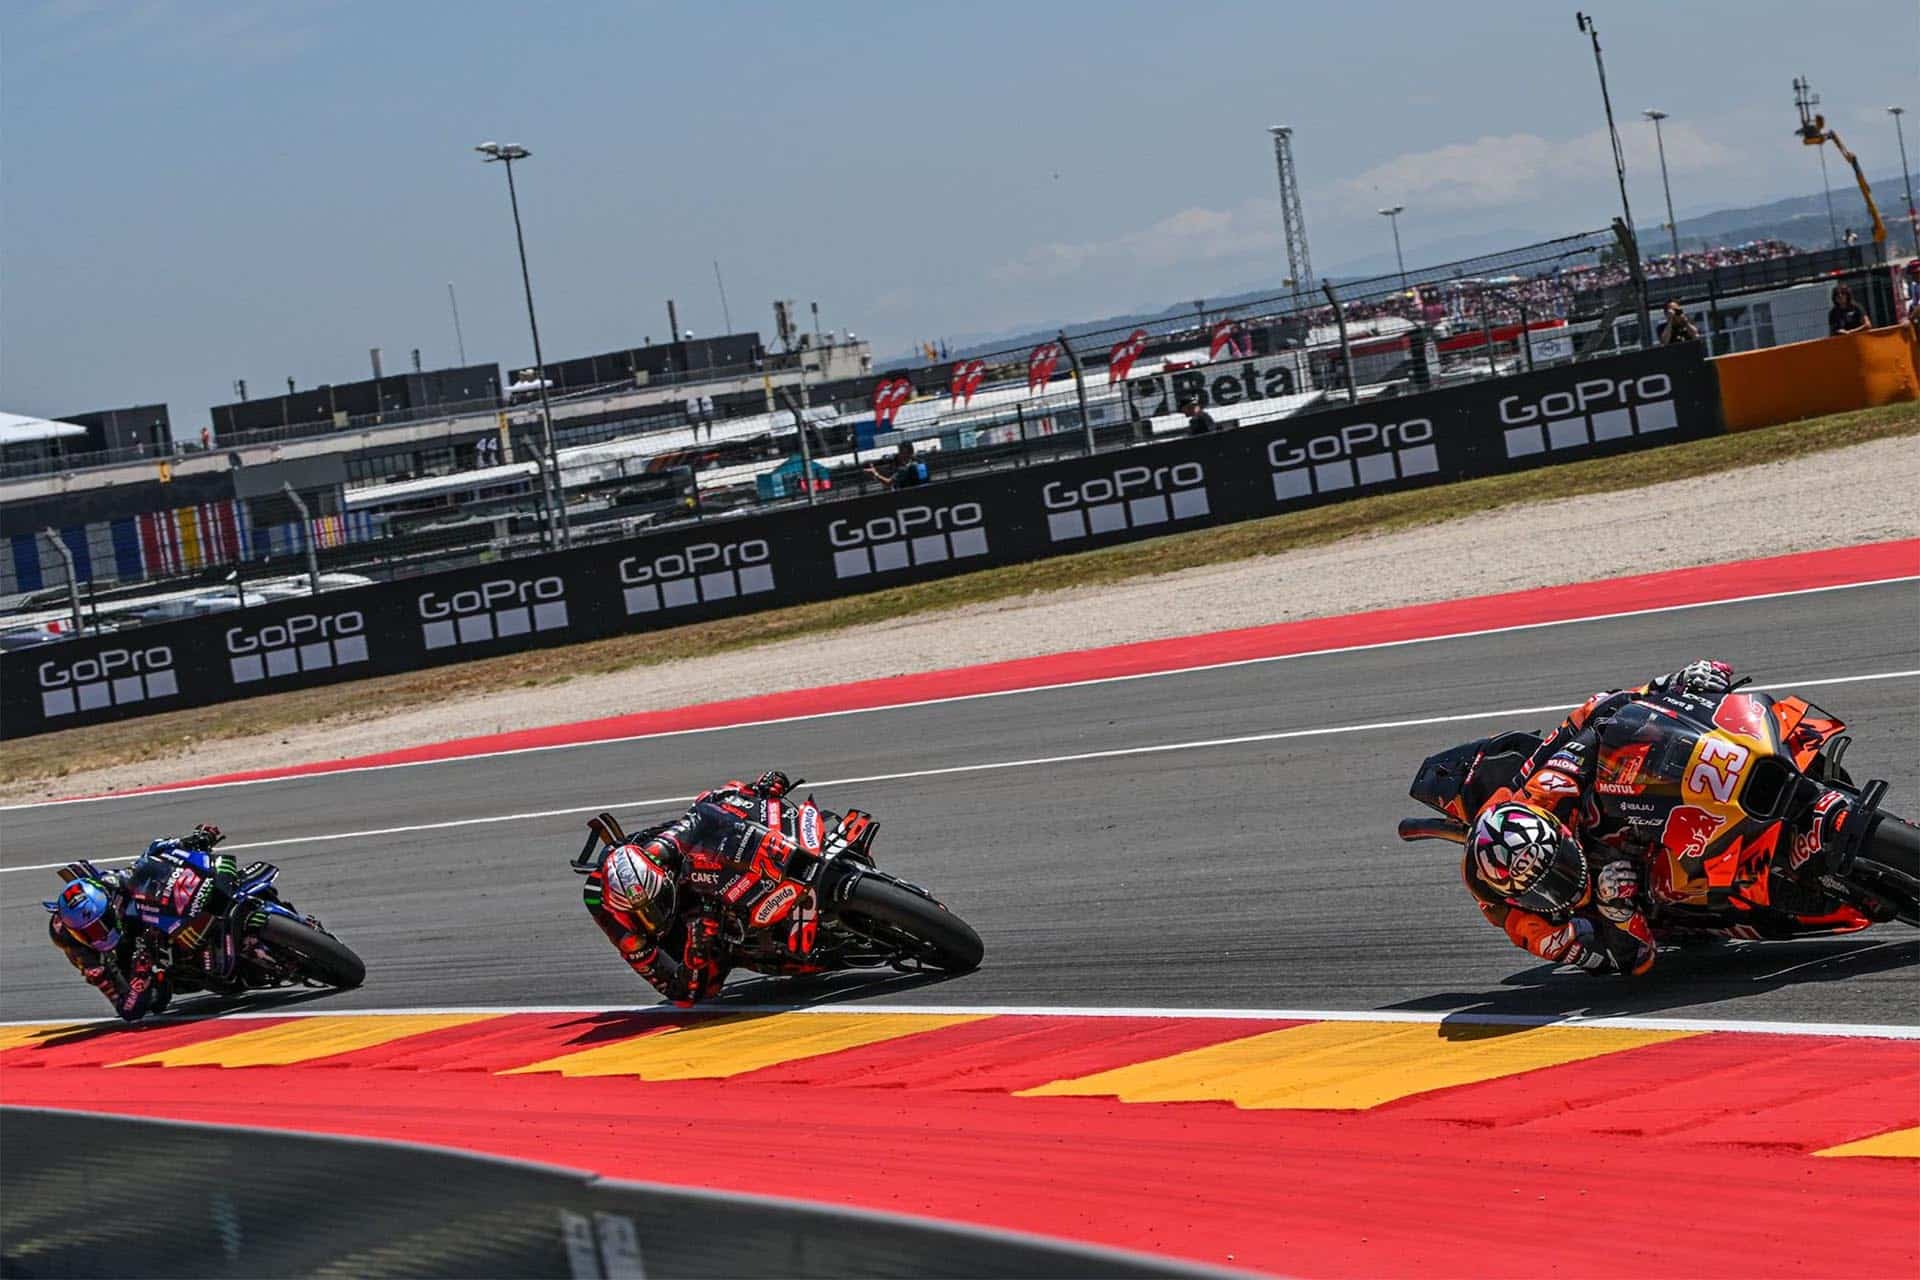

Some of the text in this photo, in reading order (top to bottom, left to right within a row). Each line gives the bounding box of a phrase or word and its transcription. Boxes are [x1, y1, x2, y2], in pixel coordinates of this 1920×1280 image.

[1172, 363, 1294, 411] Beta
[1499, 373, 1672, 424] GoPro
[1267, 418, 1433, 467] GoPro
[1042, 462, 1204, 509] GoPro
[828, 502, 982, 547] GoPro
[619, 539, 769, 584] GoPro
[418, 576, 564, 619] GoPro
[226, 611, 364, 653] GoPro
[39, 646, 173, 687] GoPro
[1600, 784, 1635, 795] MOTUL
[1689, 738, 1750, 804] 23
[806, 808, 817, 849] sterilgarda
[758, 887, 794, 921] sterilgarda
